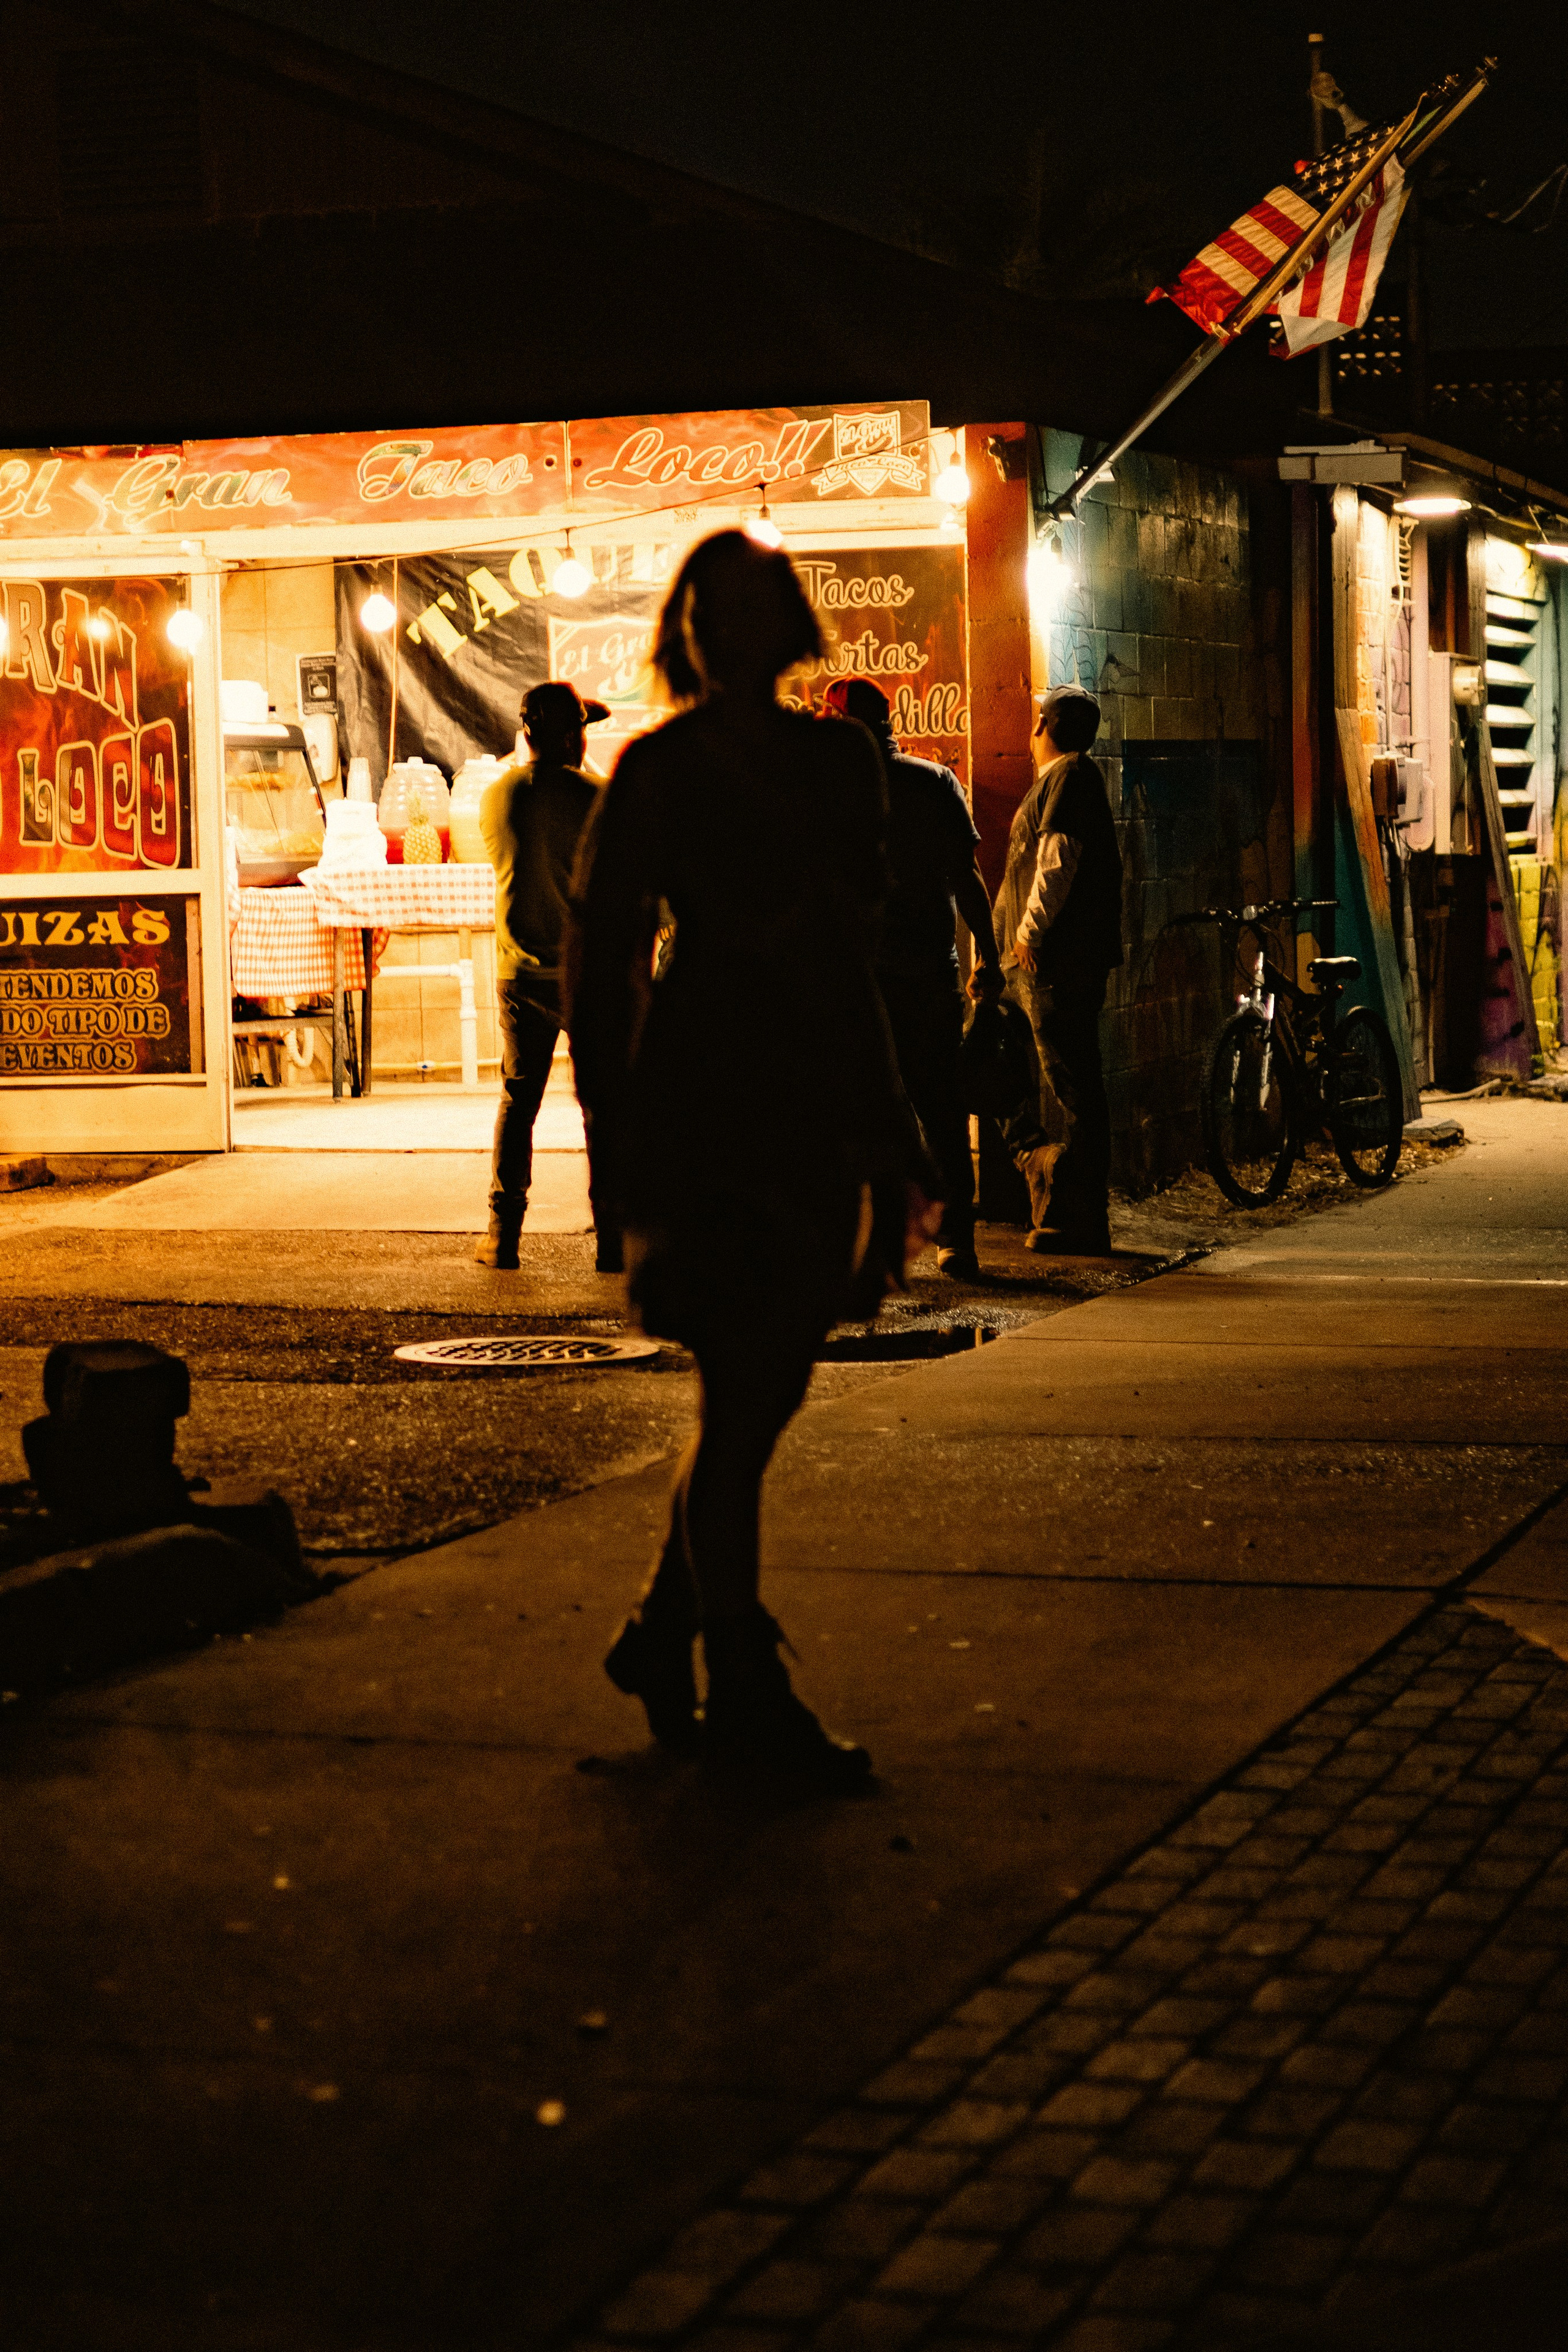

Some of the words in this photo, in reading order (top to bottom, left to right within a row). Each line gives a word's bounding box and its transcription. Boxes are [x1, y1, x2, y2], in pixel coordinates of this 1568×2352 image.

[0, 458, 62, 519] El
[101, 454, 293, 524] Gran
[358, 440, 532, 502] Taco
[583, 418, 832, 489] Loco!!
[793, 560, 914, 609] Tacos
[0, 580, 138, 733] RAN
[790, 630, 929, 680] ortas
[18, 718, 180, 870] LOCO
[47, 1003, 123, 1038] TIPO
[122, 1003, 171, 1039] DE
[0, 1039, 138, 1075] EVENTOS
